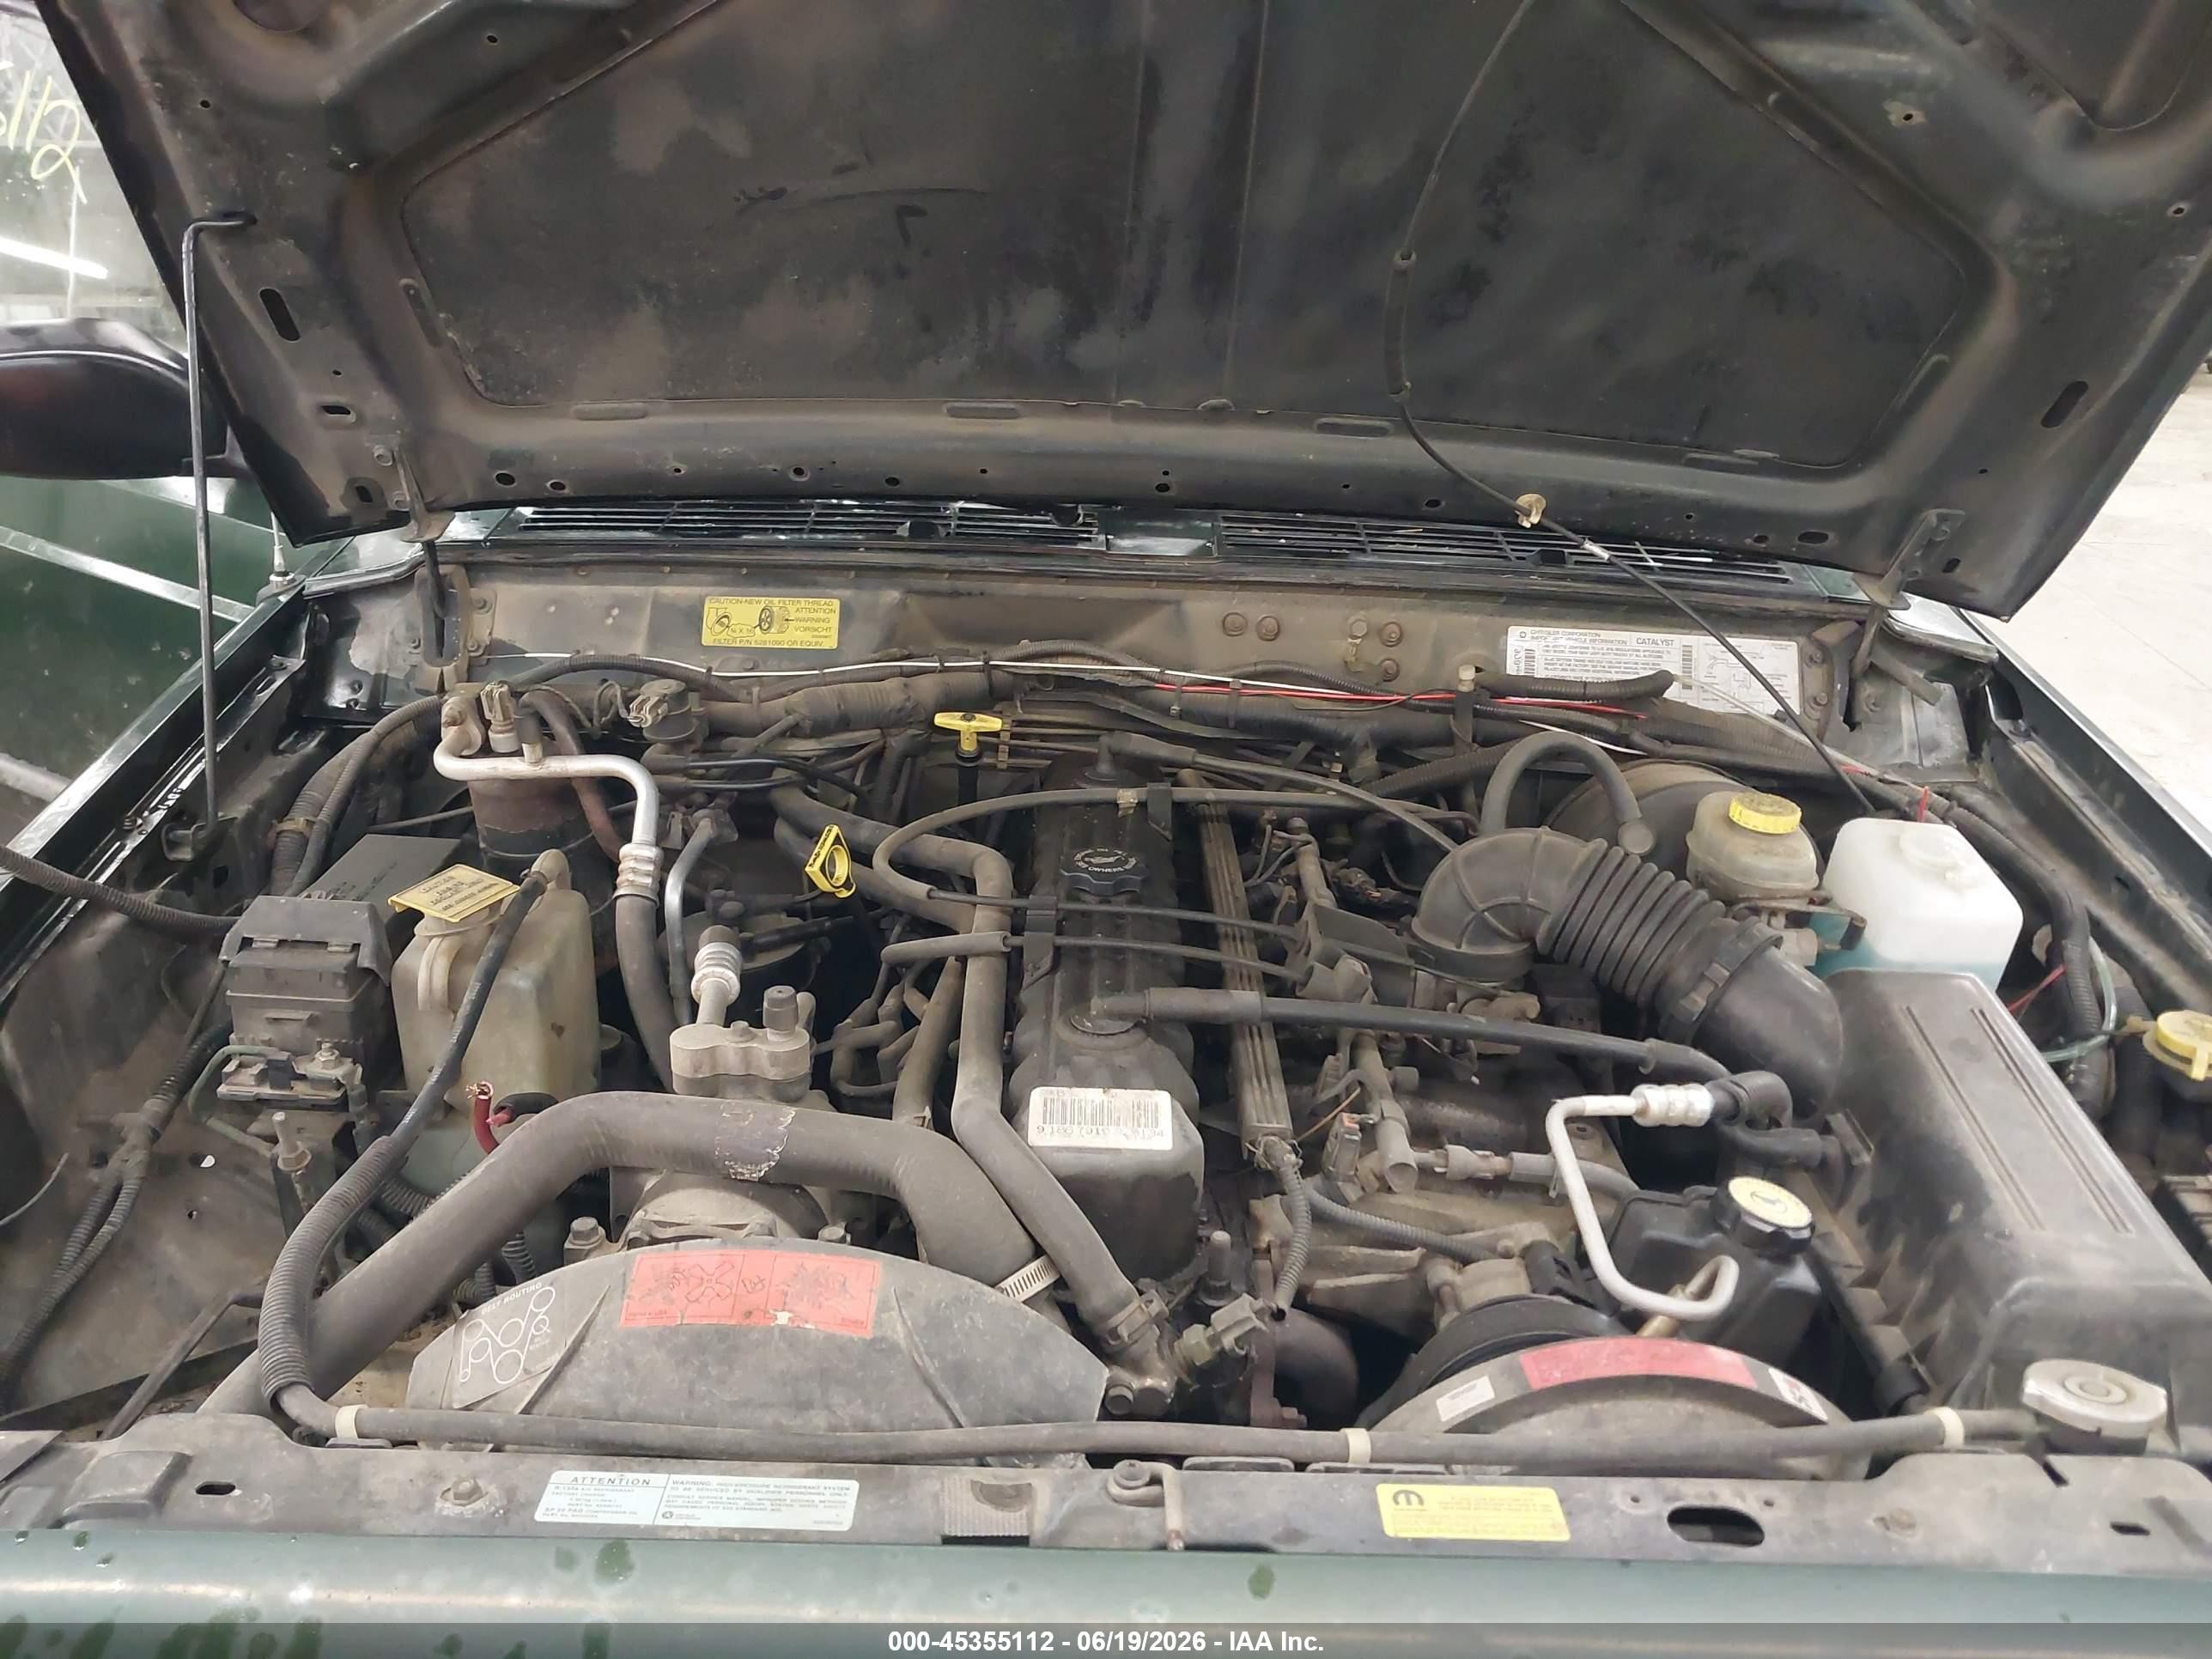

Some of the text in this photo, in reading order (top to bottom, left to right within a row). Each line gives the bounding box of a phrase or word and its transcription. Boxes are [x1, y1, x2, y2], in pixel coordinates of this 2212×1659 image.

[795, 606, 837, 615] ATTENTION
[1636, 637, 1675, 647] CATALYST
[503, 1282, 544, 1305] ROUTING
[570, 1476, 651, 1486] ATTENTION
